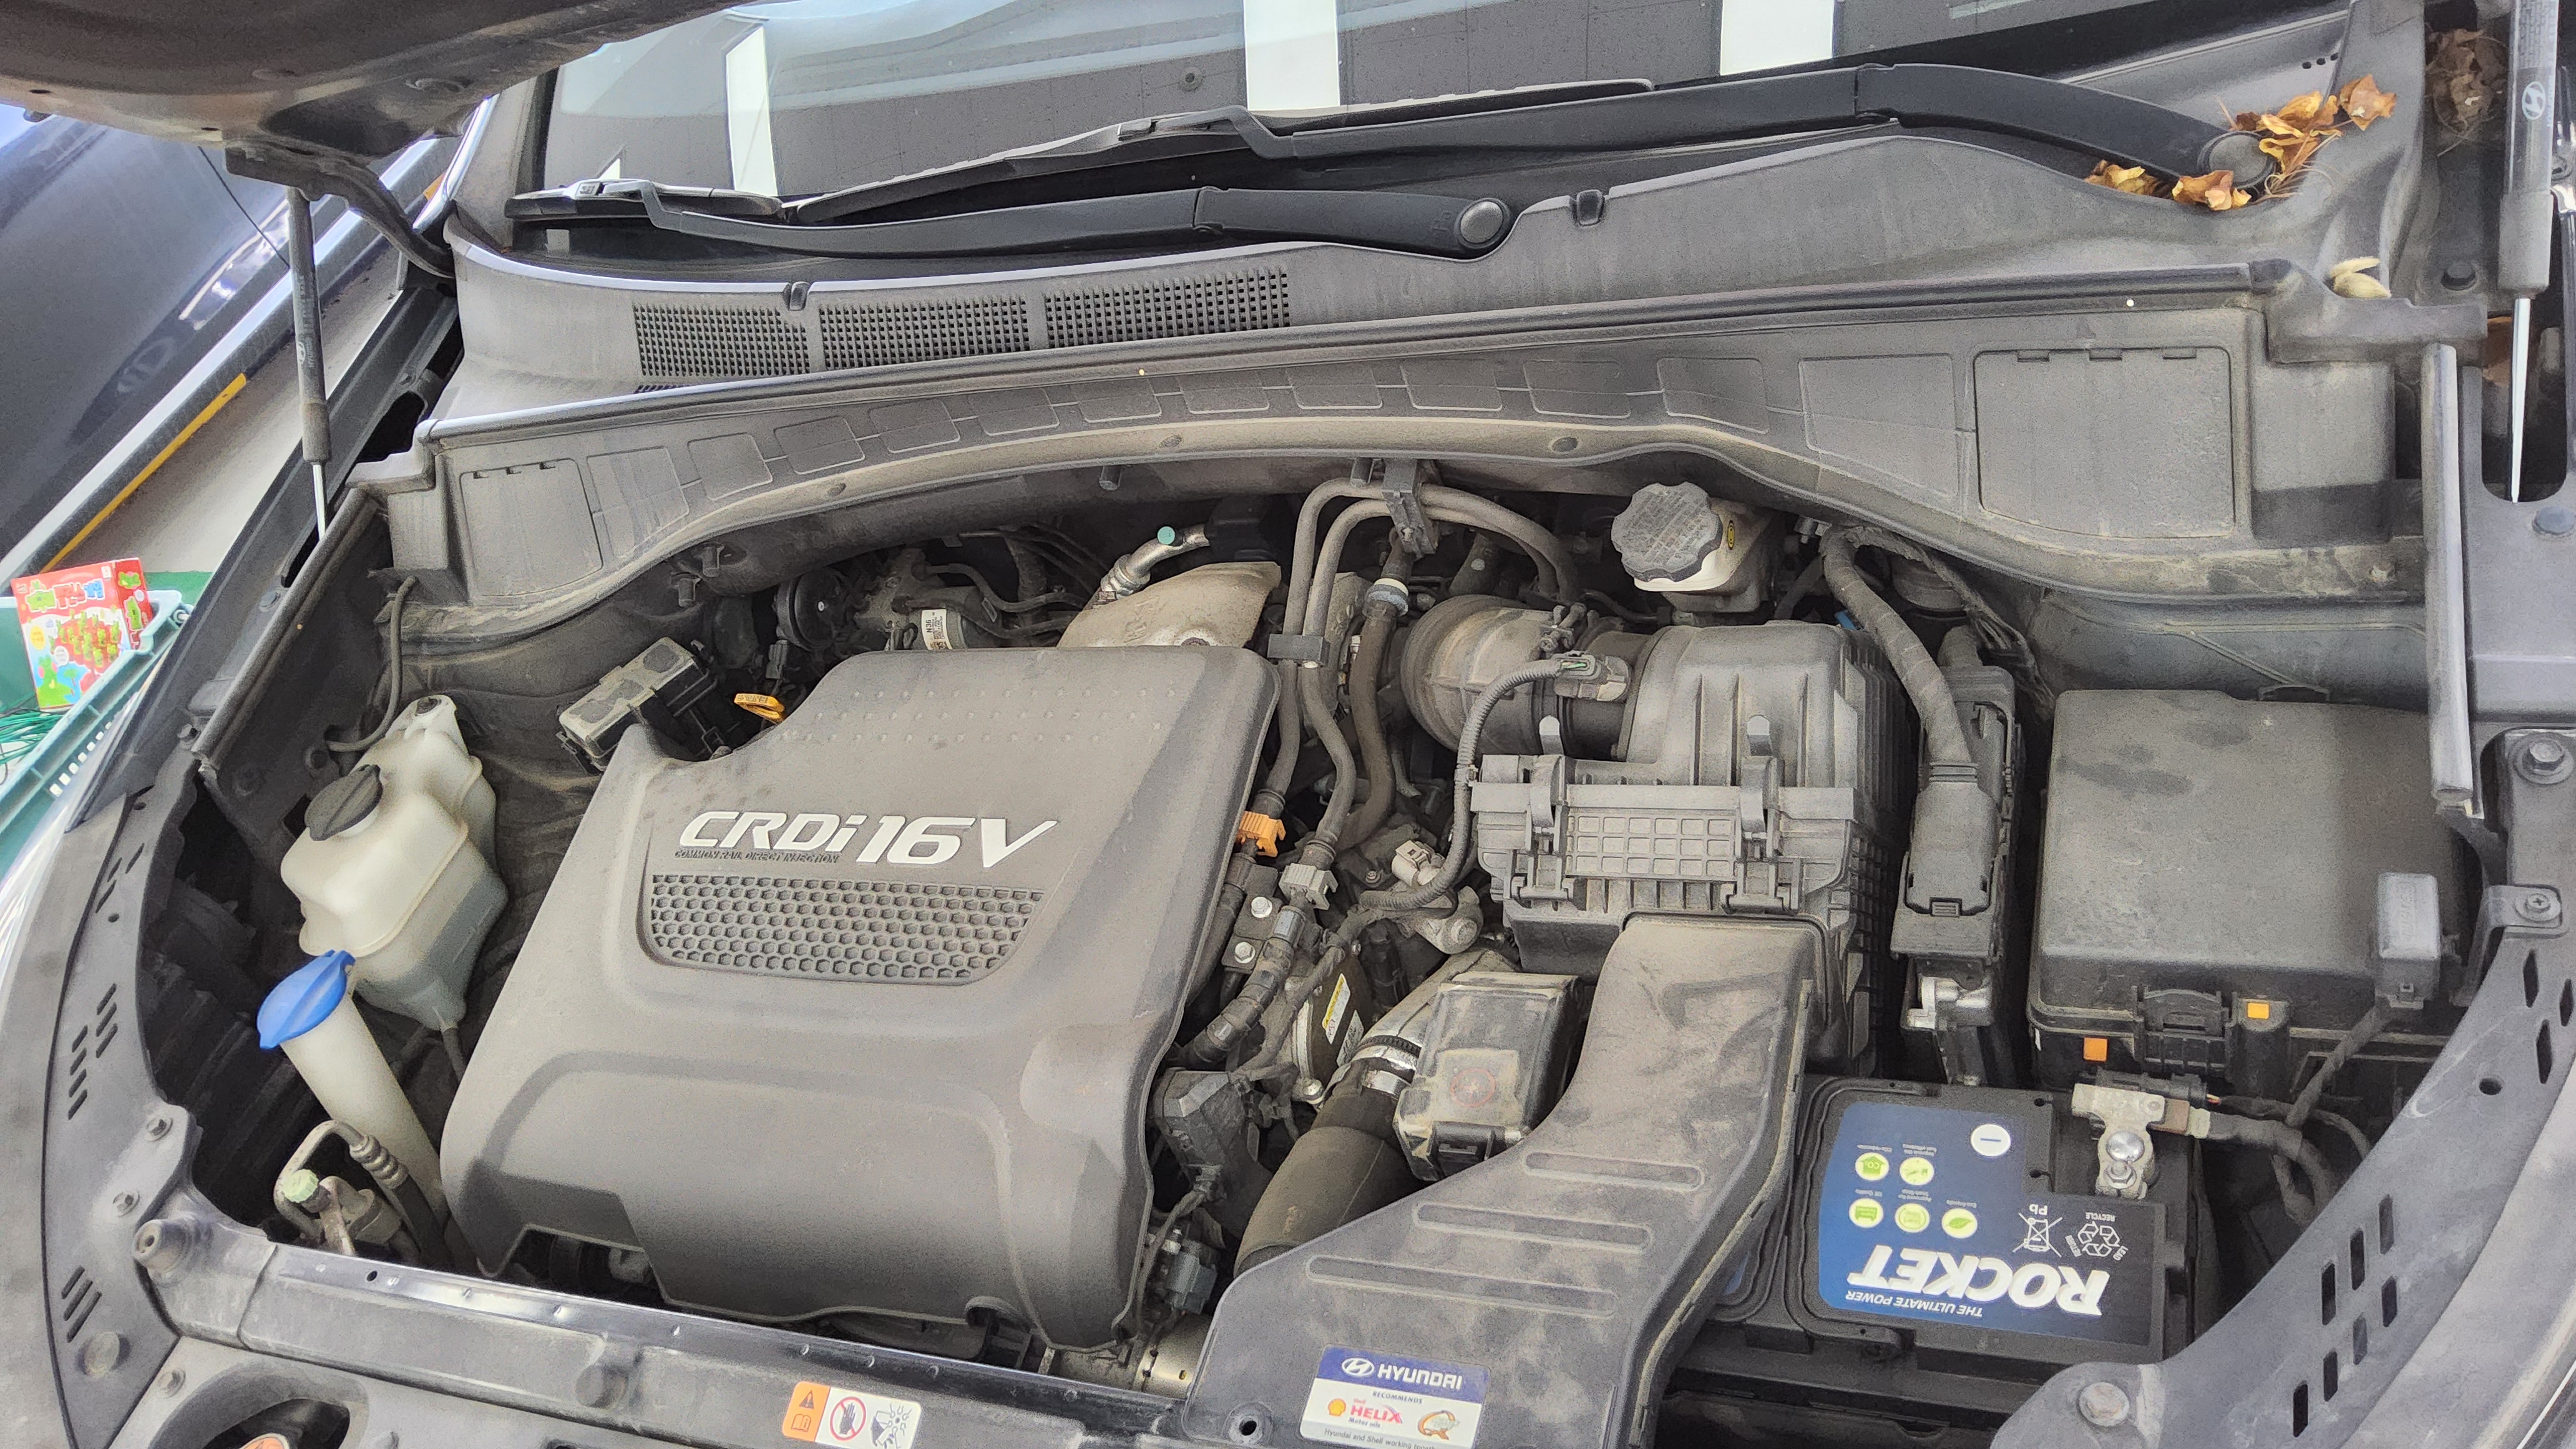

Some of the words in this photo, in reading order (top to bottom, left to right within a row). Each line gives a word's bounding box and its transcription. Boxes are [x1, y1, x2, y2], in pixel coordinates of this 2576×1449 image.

[680, 811, 868, 852] CRDi
[856, 816, 1057, 868] 16V
[675, 849, 718, 859] COMMON
[719, 851, 742, 860] RAIL
[744, 851, 783, 861] DIRECT
[783, 852, 840, 864] INJECTION
[2029, 1203, 2048, 1216] Pb
[2085, 1212, 2115, 1222] RECYCLE
[2112, 1245, 2129, 1261] LEAD
[1847, 1245, 2110, 1315] ROCKET
[1845, 1290, 1893, 1305] POWER
[1893, 1297, 1956, 1314] ULTIMATE
[1956, 1305, 1983, 1318] THE
[1378, 1364, 1462, 1389] HYUNDAI
[1372, 1391, 1423, 1404] RECOMMENDS
[1348, 1417, 1368, 1426] Motor
[1350, 1405, 1403, 1424] HELIX
[1324, 1428, 1351, 1439] Hyundai
[1352, 1433, 1365, 1442] and
[1367, 1435, 1383, 1445] Shell
[1385, 1438, 1412, 1449] working
